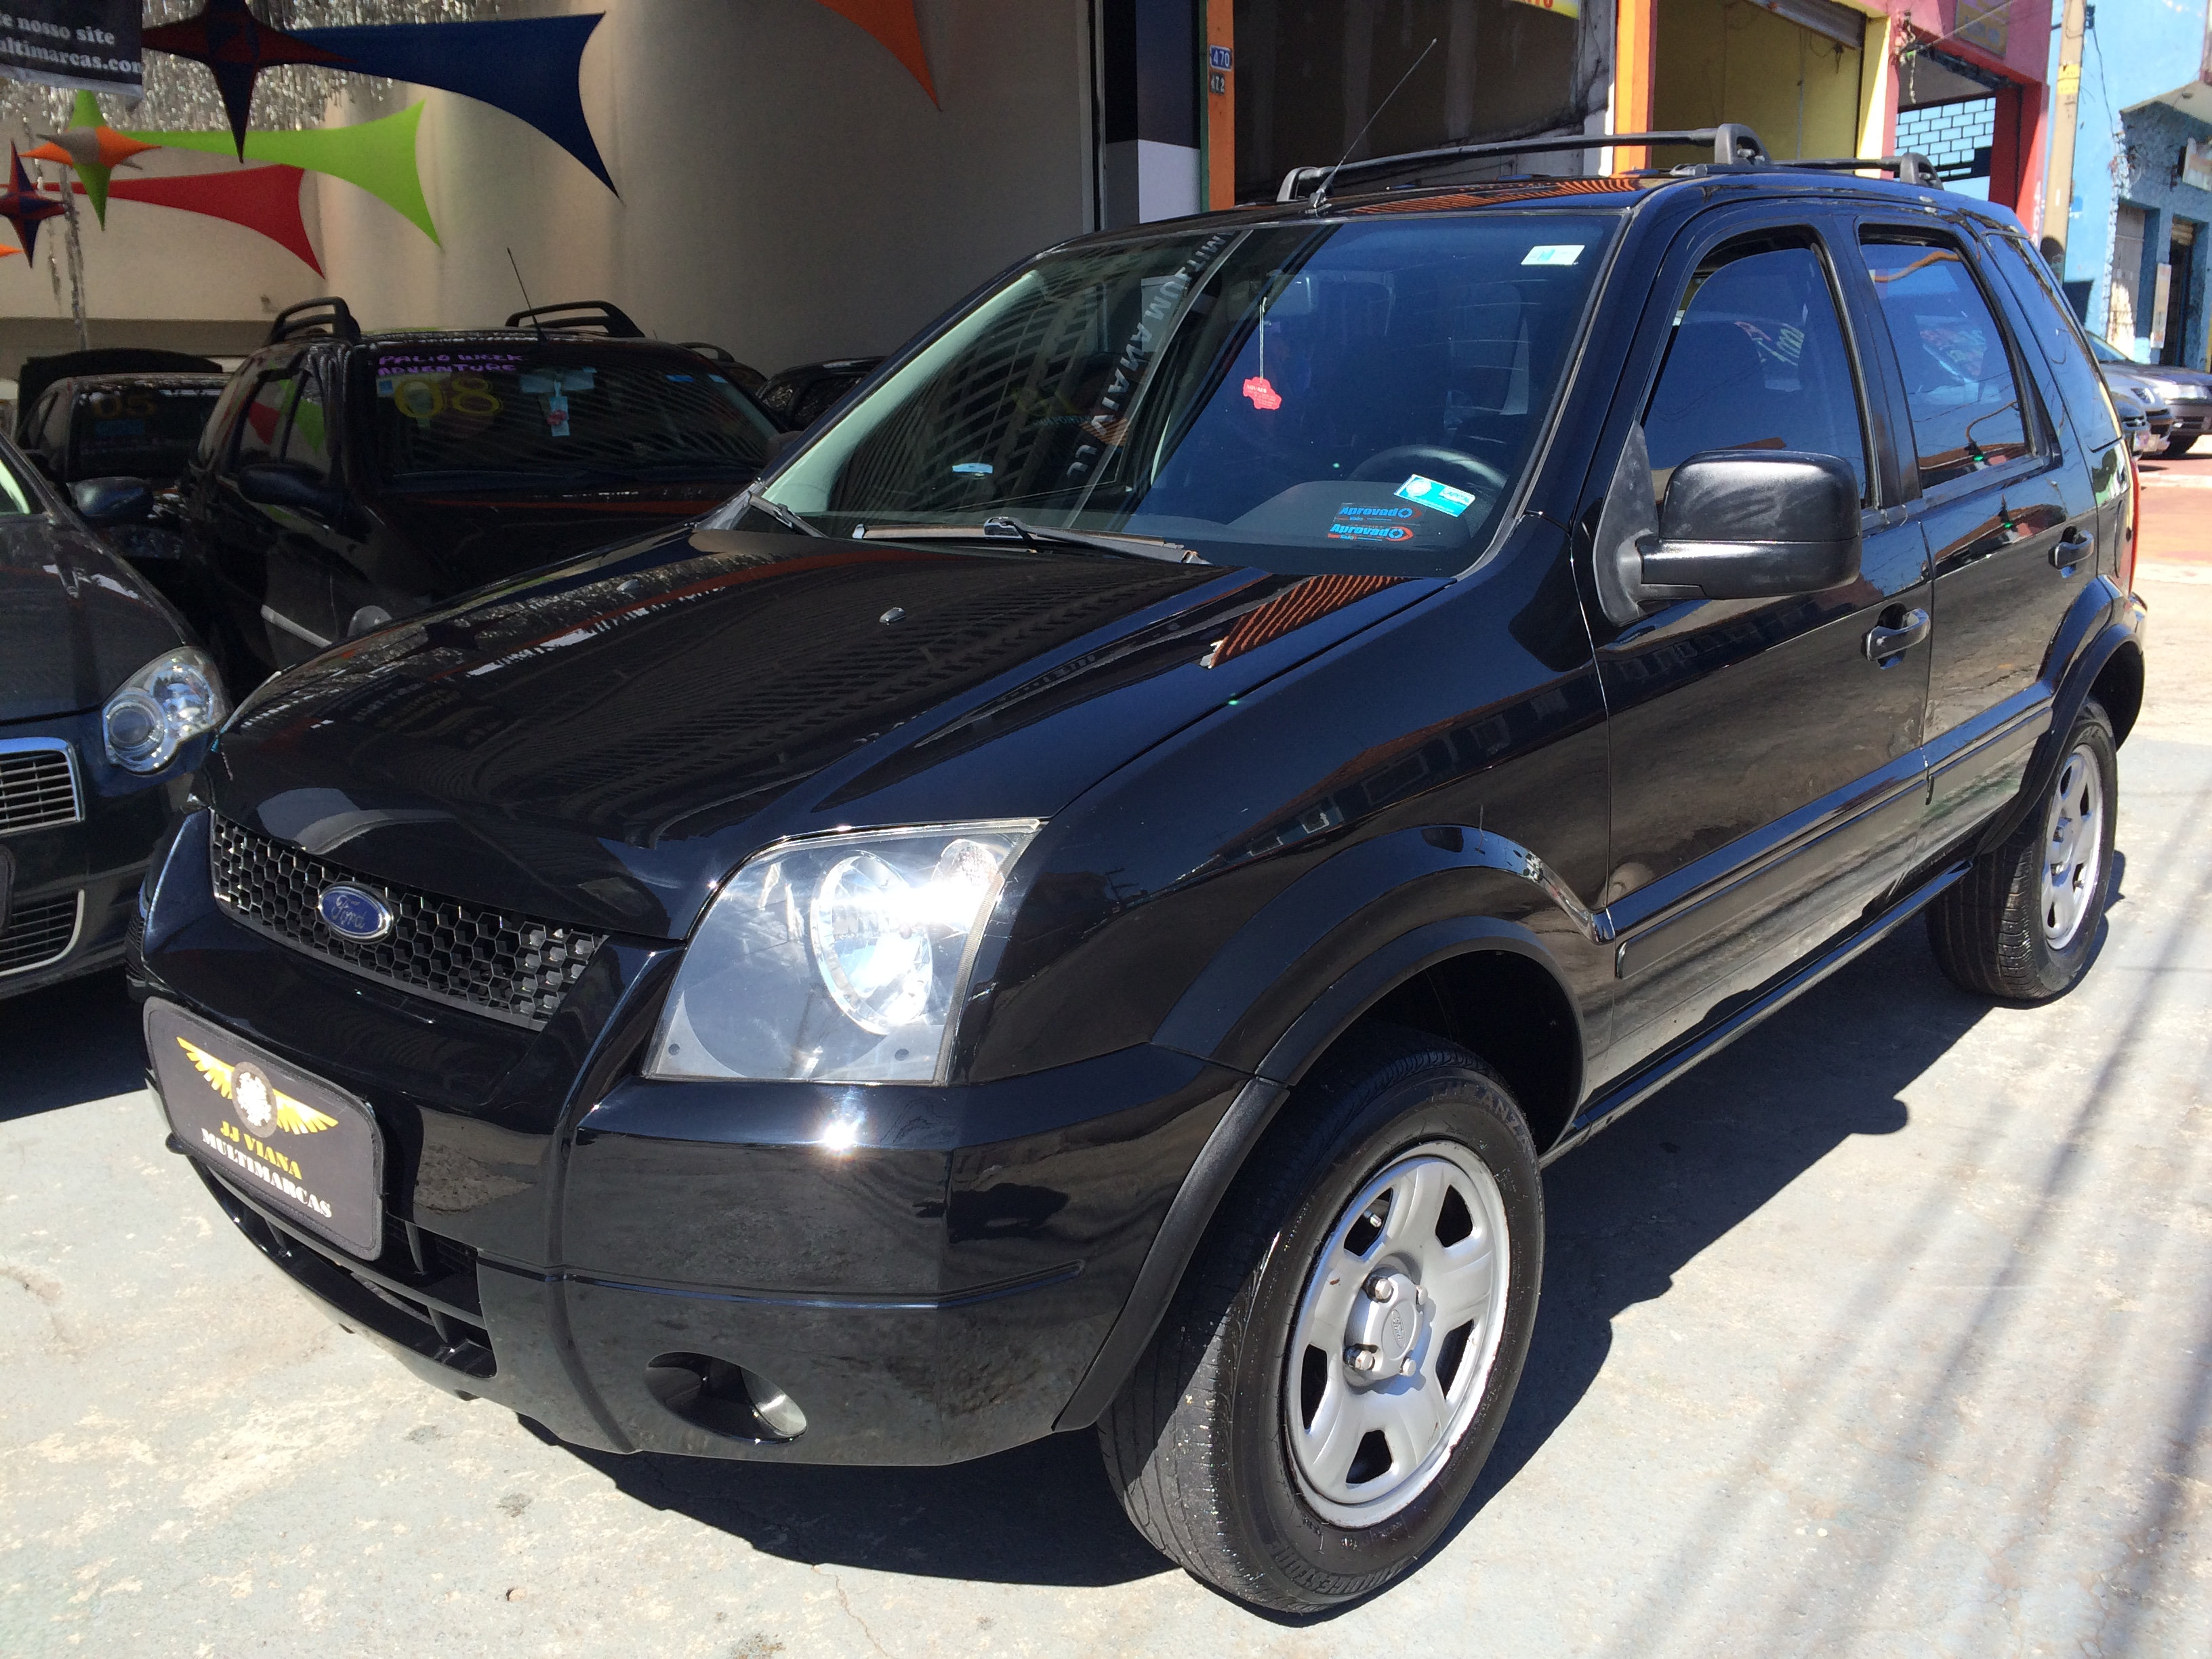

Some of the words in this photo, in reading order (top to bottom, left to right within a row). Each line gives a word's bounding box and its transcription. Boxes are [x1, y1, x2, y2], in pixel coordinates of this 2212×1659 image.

[17, 18, 70, 39] nosso
[76, 26, 115, 45] site
[1213, 48, 1229, 67] 470
[378, 354, 451, 365] PALIO
[1338, 506, 1413, 518] Aprovado
[1330, 523, 1404, 539] Aprovado
[330, 895, 367, 929] Ford
[220, 1120, 240, 1143] JJ
[243, 1133, 302, 1180] VIANA
[201, 1128, 332, 1218] MULTIMARCAS
